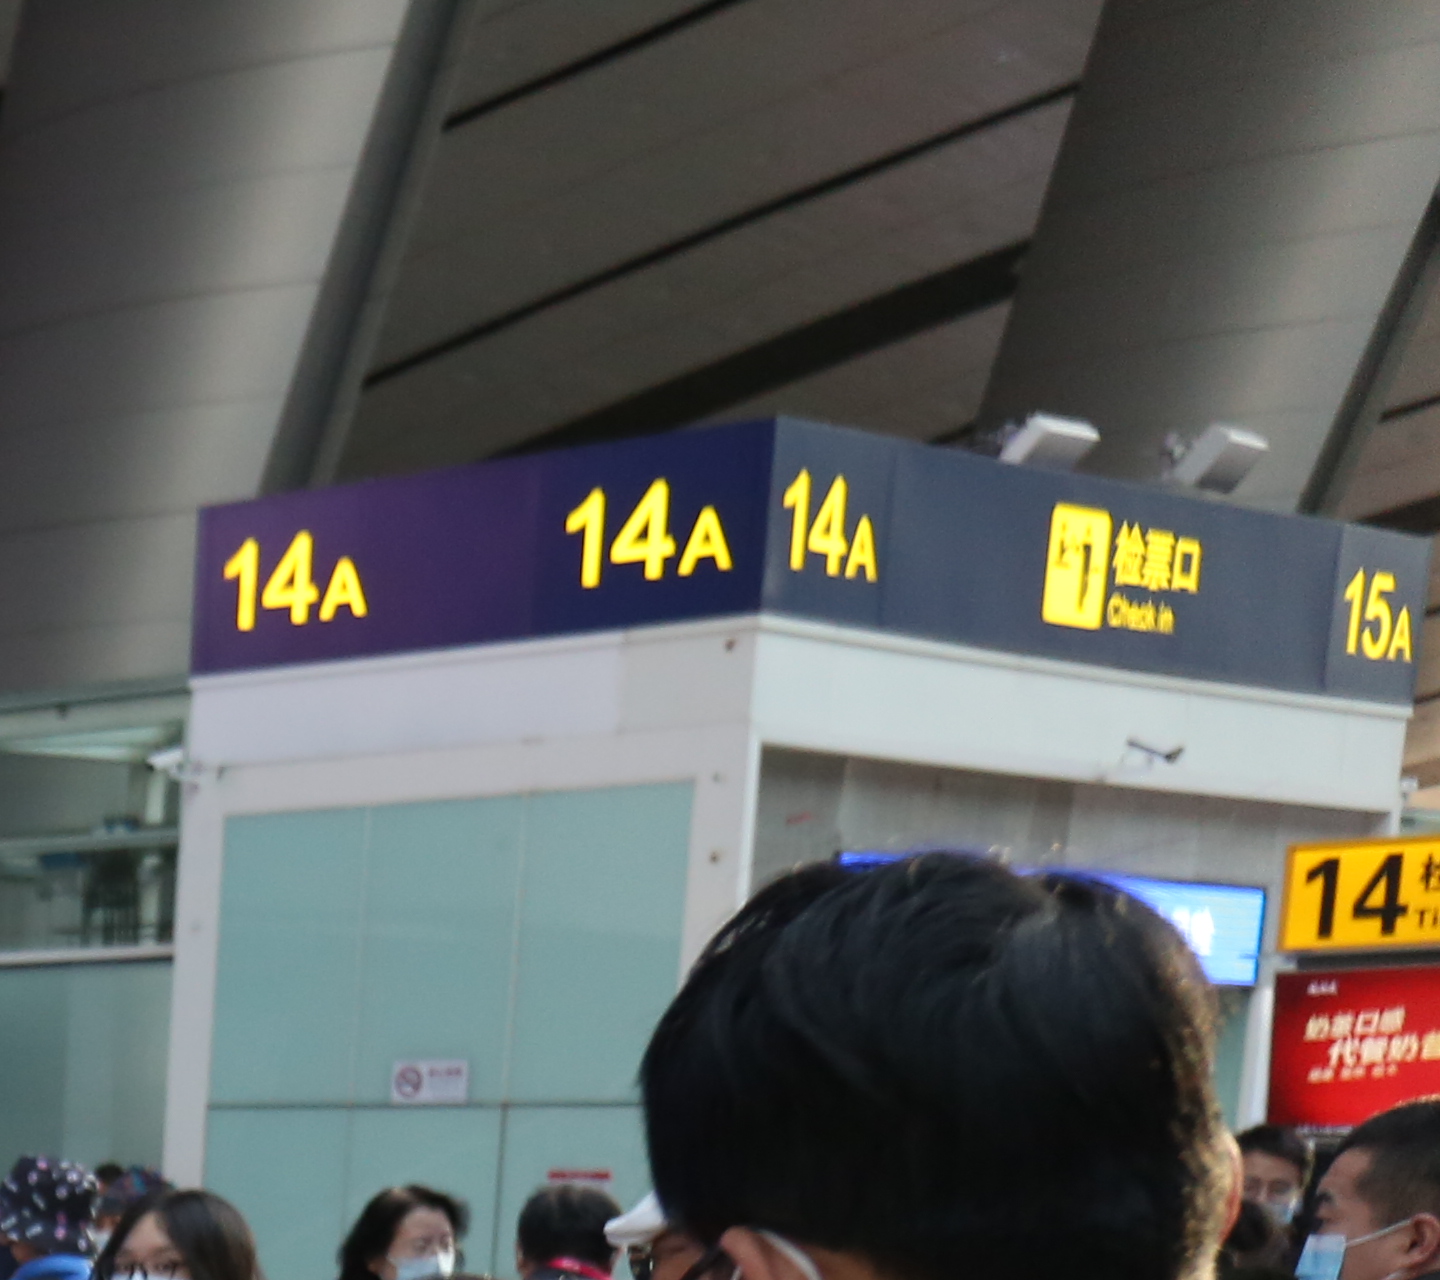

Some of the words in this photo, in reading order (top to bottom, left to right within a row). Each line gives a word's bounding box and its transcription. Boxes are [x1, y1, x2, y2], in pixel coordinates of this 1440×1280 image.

[565, 478, 732, 589] 14A
[783, 468, 877, 582] 14A
[1113, 520, 1202, 594] 检票口
[223, 530, 367, 632] 14A
[1343, 566, 1412, 664] 15A
[1306, 853, 1408, 939] 14
